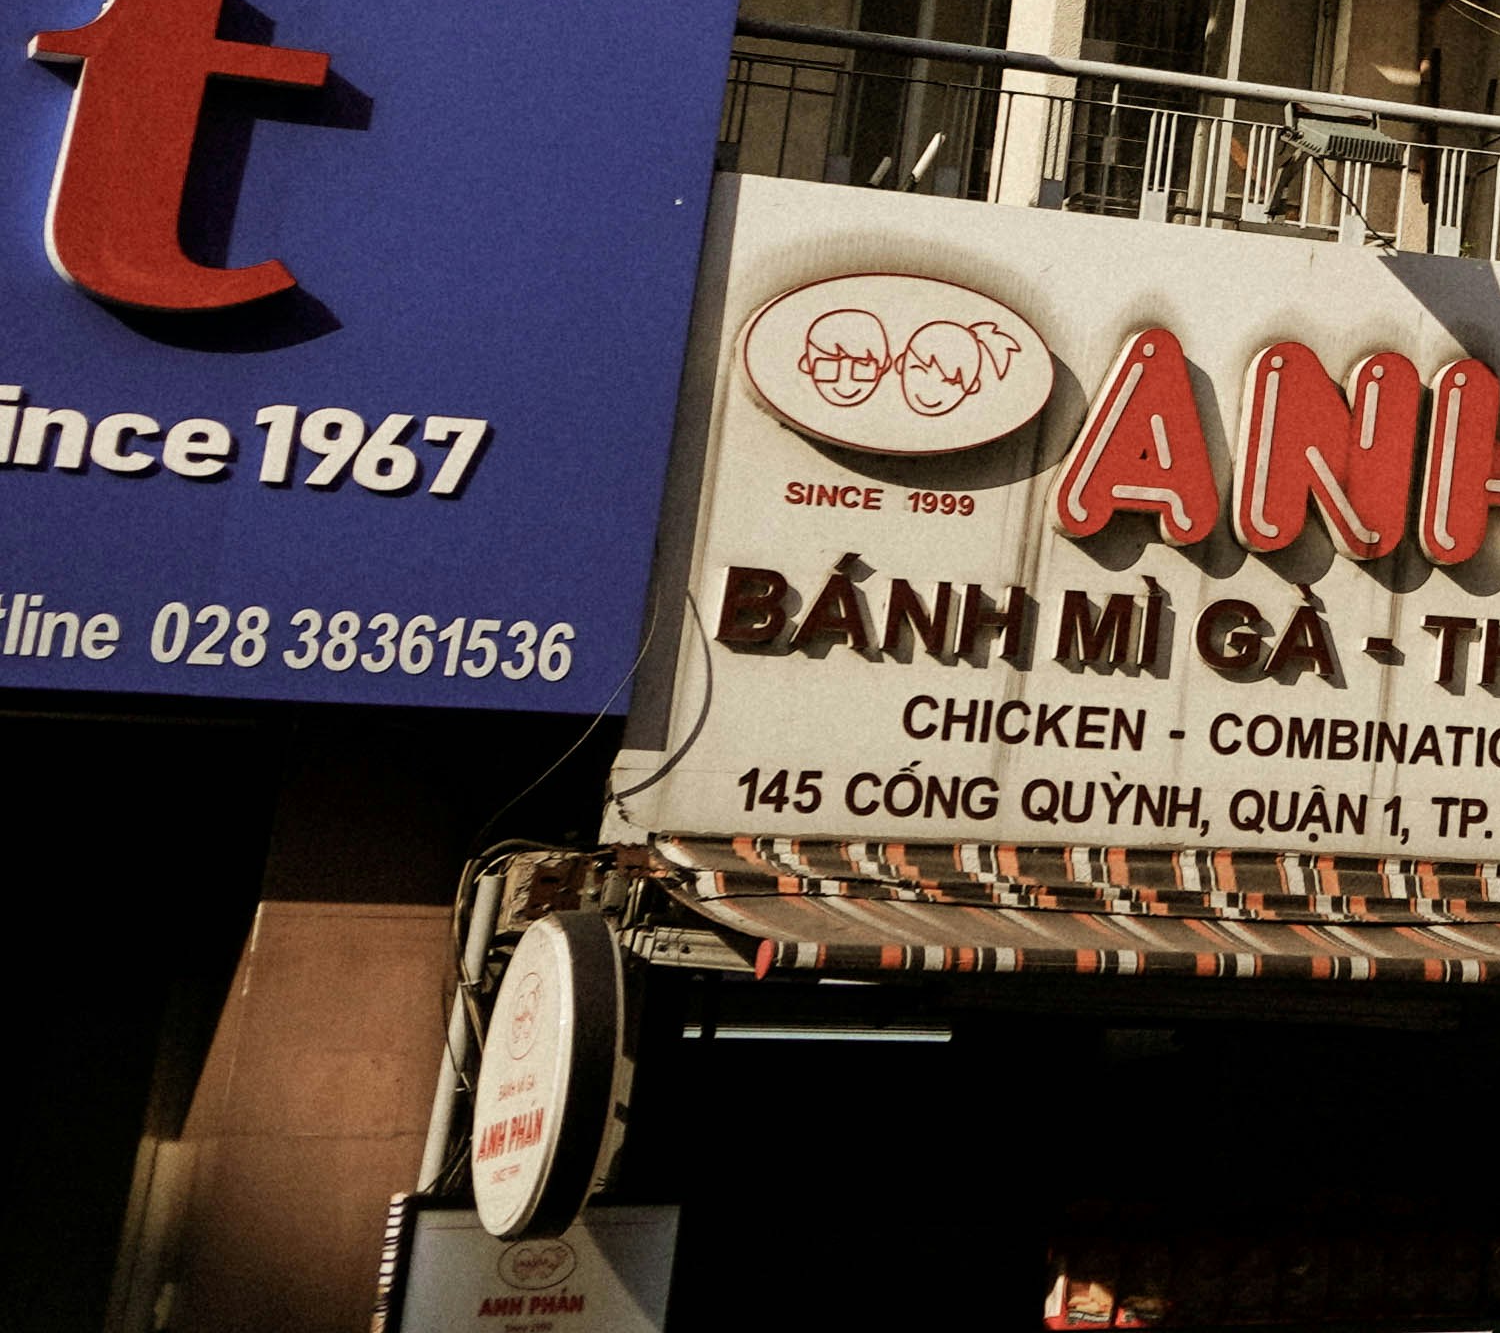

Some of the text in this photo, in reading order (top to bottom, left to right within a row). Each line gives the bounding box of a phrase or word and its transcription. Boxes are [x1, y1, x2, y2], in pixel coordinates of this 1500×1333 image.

[255, 403, 489, 496] 1967
[784, 481, 976, 517] SINCE 1999
[150, 600, 270, 668] 028
[283, 609, 576, 683] 38361536
[715, 553, 1030, 663] BÁNH
[1052, 575, 1167, 671] MÌ
[1196, 585, 1337, 679] GÀ
[902, 694, 1147, 752] CHICKEN
[738, 767, 823, 815] 145
[844, 761, 1000, 821] CỐNG
[1020, 772, 1212, 837] QUỲNH,
[1228, 787, 1368, 850] QUẬN
[1381, 797, 1411, 845] 1,
[1431, 796, 1493, 840] TP.
